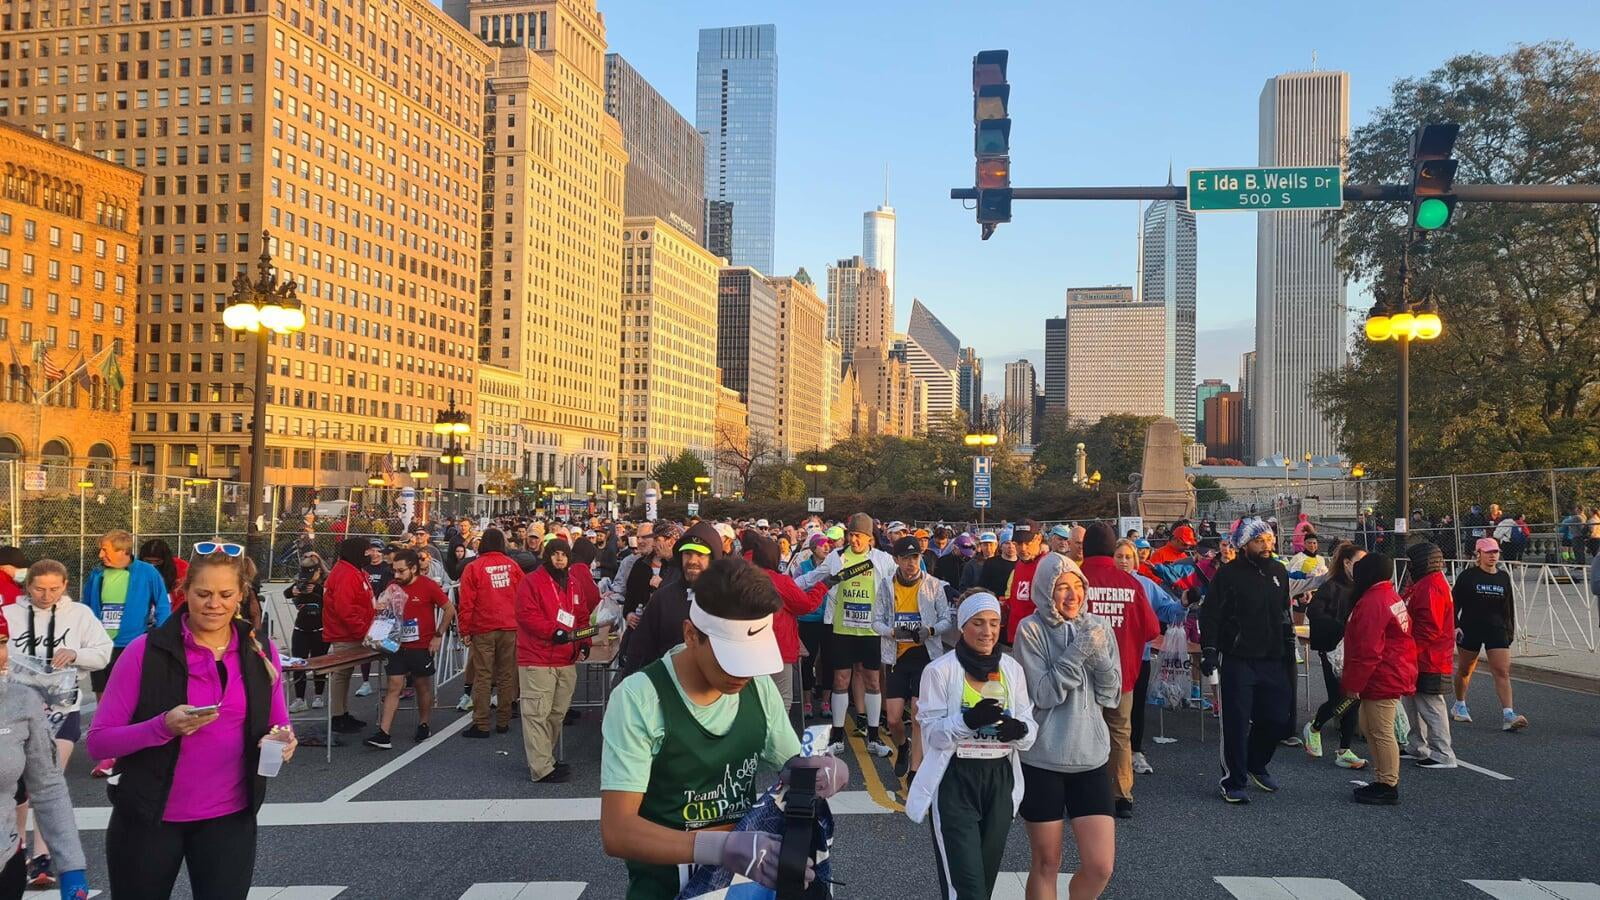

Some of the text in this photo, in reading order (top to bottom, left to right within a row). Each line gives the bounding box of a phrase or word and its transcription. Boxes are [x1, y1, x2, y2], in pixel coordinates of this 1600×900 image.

[1198, 173, 1331, 190] E Ida B. Wells Dr
[1239, 193, 1291, 205] 500 S
[976, 457, 989, 473] H
[842, 589, 870, 599] RAFAEL
[1088, 586, 1136, 603] ONTERREY
[1092, 602, 1125, 615] EVENT
[684, 790, 719, 803] Team
